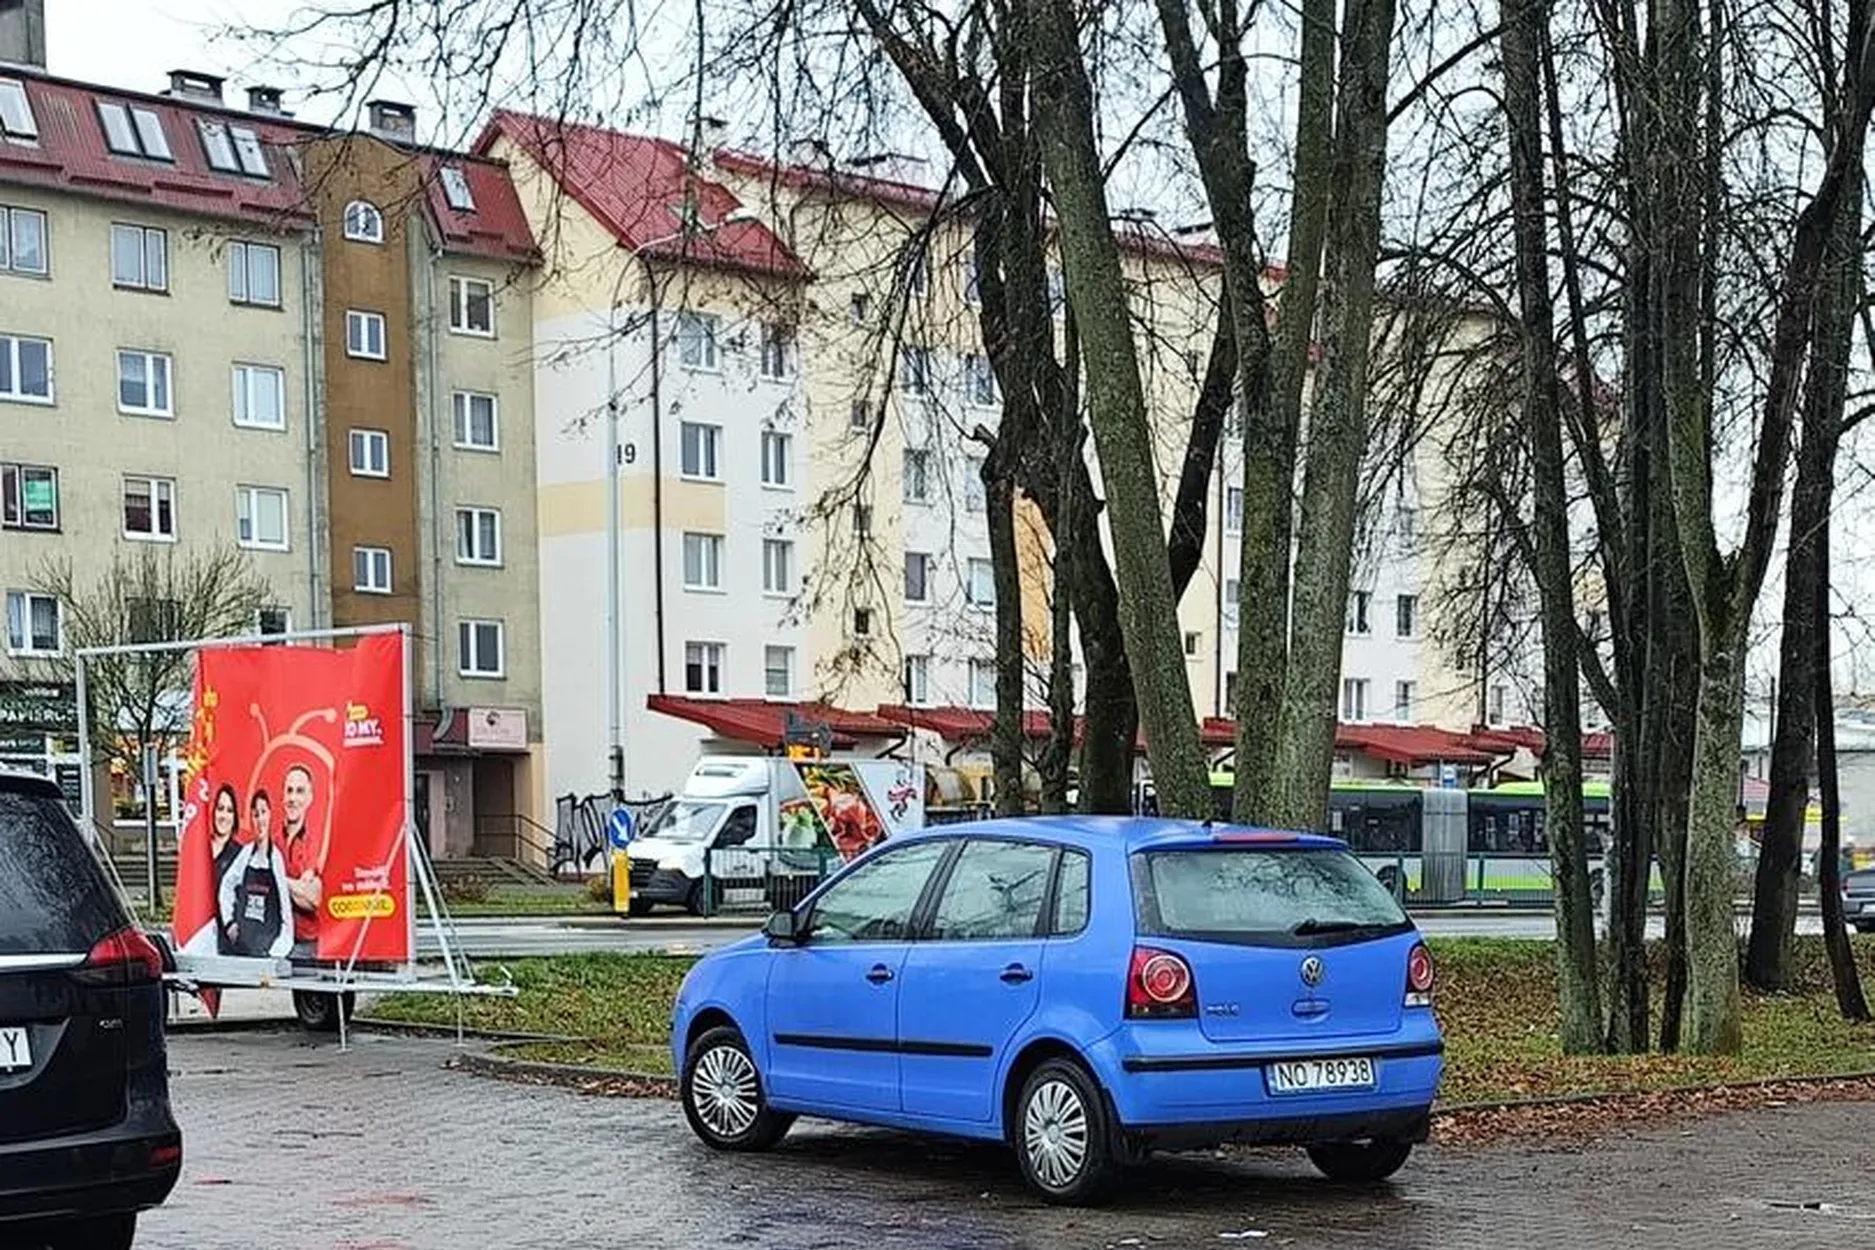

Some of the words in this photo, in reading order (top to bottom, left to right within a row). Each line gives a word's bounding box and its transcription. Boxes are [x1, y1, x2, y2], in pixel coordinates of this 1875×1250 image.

[617, 443, 635, 464] 19
[1278, 1063, 1308, 1088] NO
[1312, 1059, 1371, 1085] 78938
